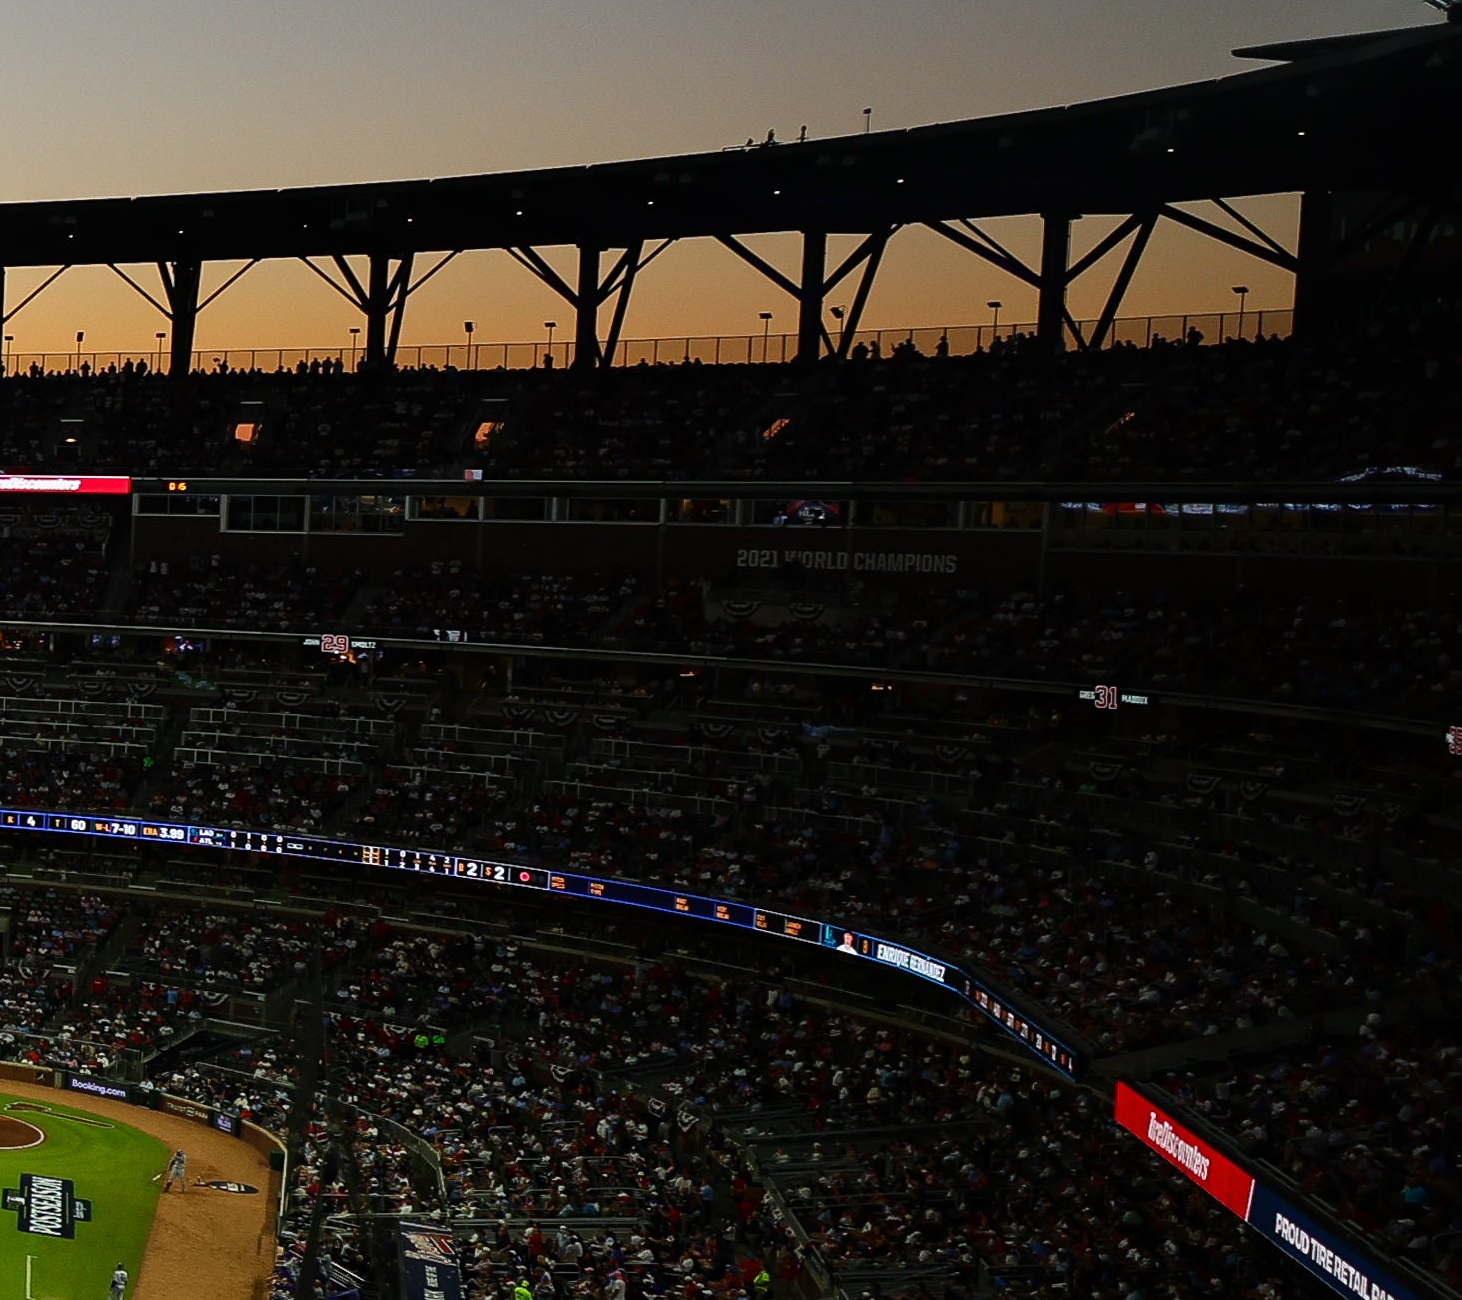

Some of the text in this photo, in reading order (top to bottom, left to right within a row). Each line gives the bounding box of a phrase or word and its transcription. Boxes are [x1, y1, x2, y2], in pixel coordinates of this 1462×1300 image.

[736, 549, 779, 568] 2021
[854, 552, 958, 573] CHAMPIONS
[321, 634, 349, 653] 29
[1095, 685, 1117, 709] 31
[71, 819, 184, 840] 60 7-10 3.99
[467, 862, 505, 880] 2 2
[877, 944, 908, 967] ENRIQUE
[71, 1078, 126, 1098] Booking.com
[1148, 1112, 1210, 1181] TireDiscounters
[29, 1176, 62, 1235] POSTSEASON
[1275, 1213, 1309, 1257] PROUD
[1310, 1238, 1333, 1273] TIRE
